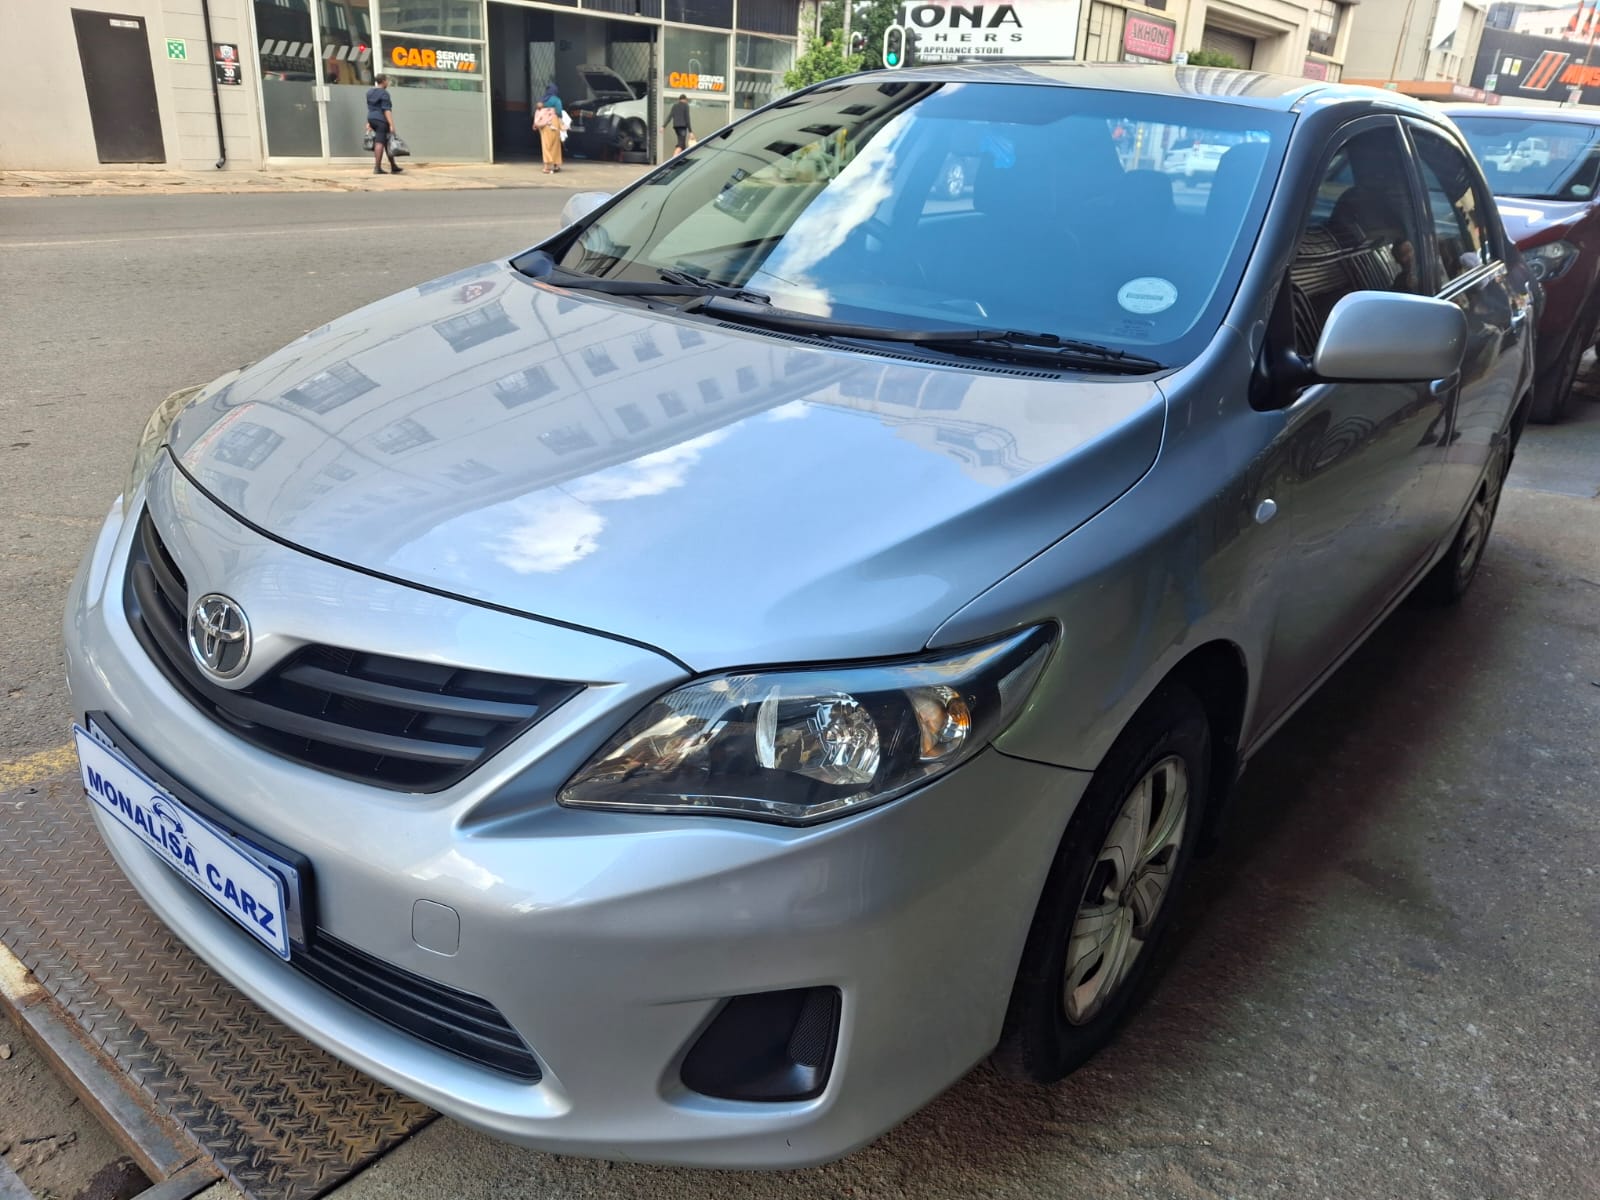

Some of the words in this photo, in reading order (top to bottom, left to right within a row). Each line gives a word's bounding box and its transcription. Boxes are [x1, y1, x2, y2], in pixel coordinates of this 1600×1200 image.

[392, 46, 436, 68] CAR
[436, 50, 475, 62] SERVICE
[923, 46, 972, 54] APPLIANCE
[436, 60, 459, 70] CITY
[669, 71, 698, 89] CAR
[87, 765, 200, 876] MONALISA
[206, 863, 277, 938] CARZ
